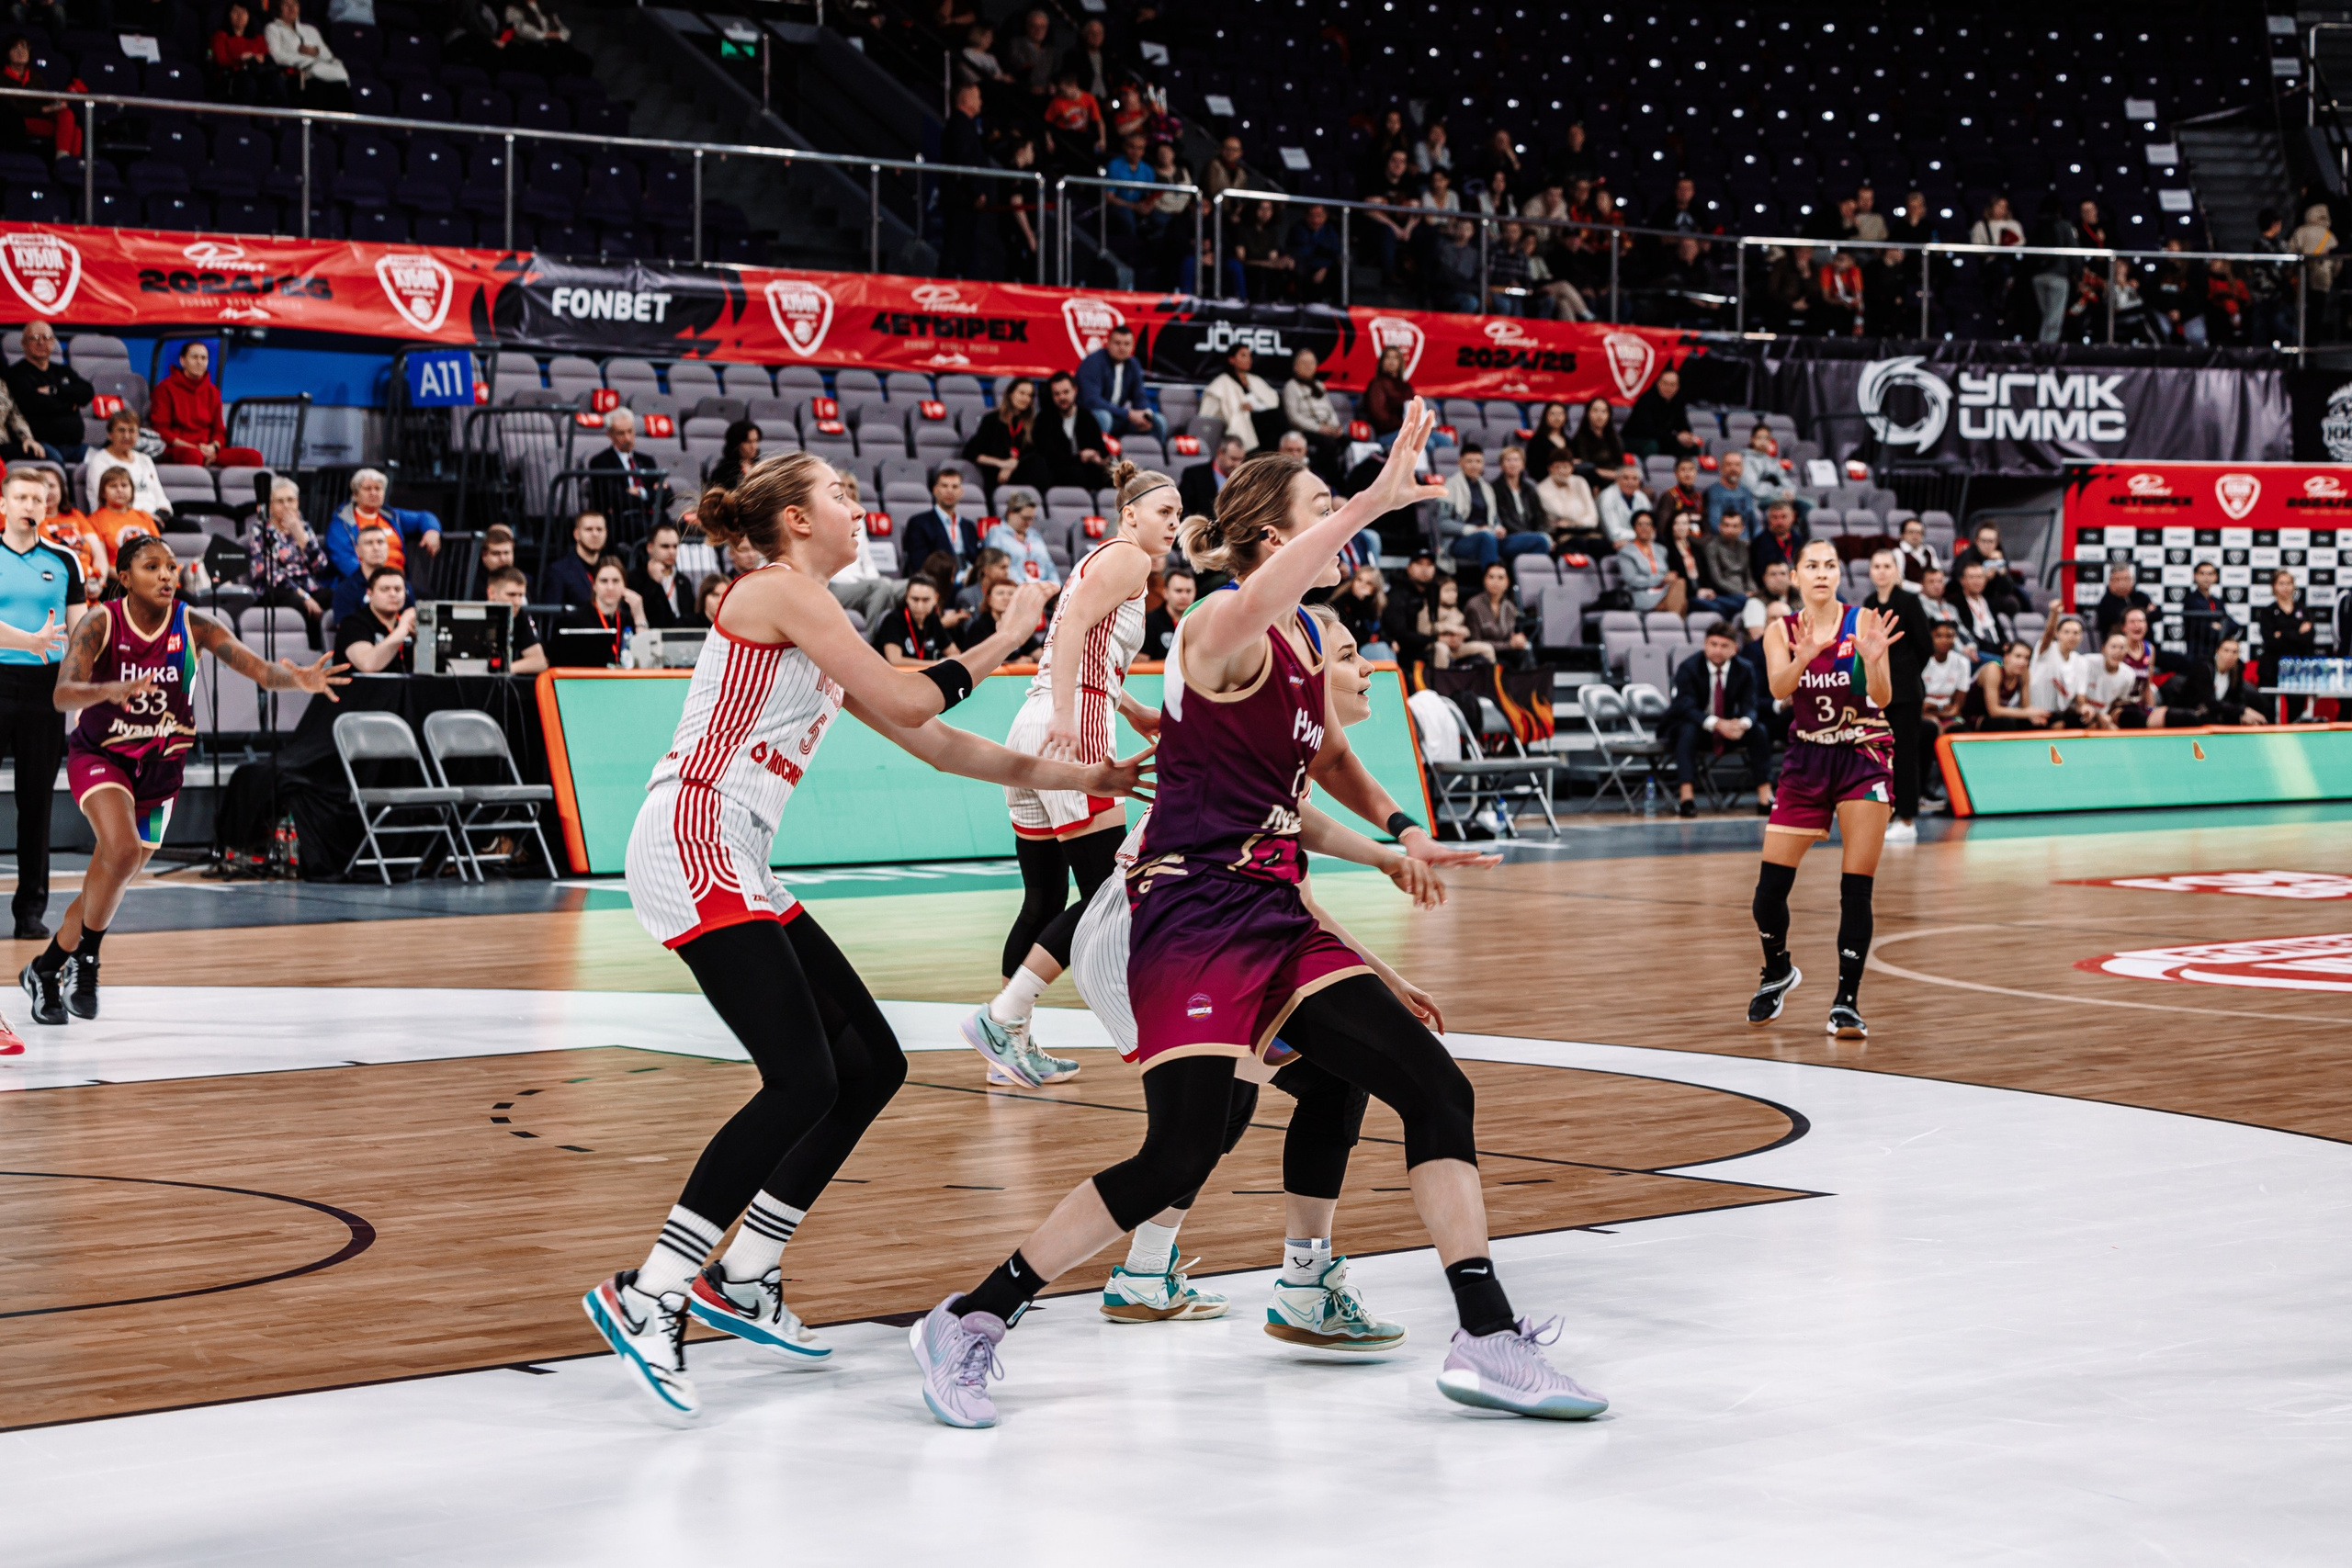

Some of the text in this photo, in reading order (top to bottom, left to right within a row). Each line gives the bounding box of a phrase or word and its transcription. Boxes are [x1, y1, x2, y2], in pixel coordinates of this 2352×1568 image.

[551, 286, 673, 323] FONBET
[1194, 319, 1293, 356] JÖGEL
[1456, 346, 1577, 373] 2024/25
[420, 360, 463, 398] A11
[1958, 372, 2125, 409] УГМК
[1958, 407, 2127, 442] UMMC
[120, 662, 179, 682] Ника
[130, 689, 168, 716] 33
[1815, 695, 1836, 722] 3
